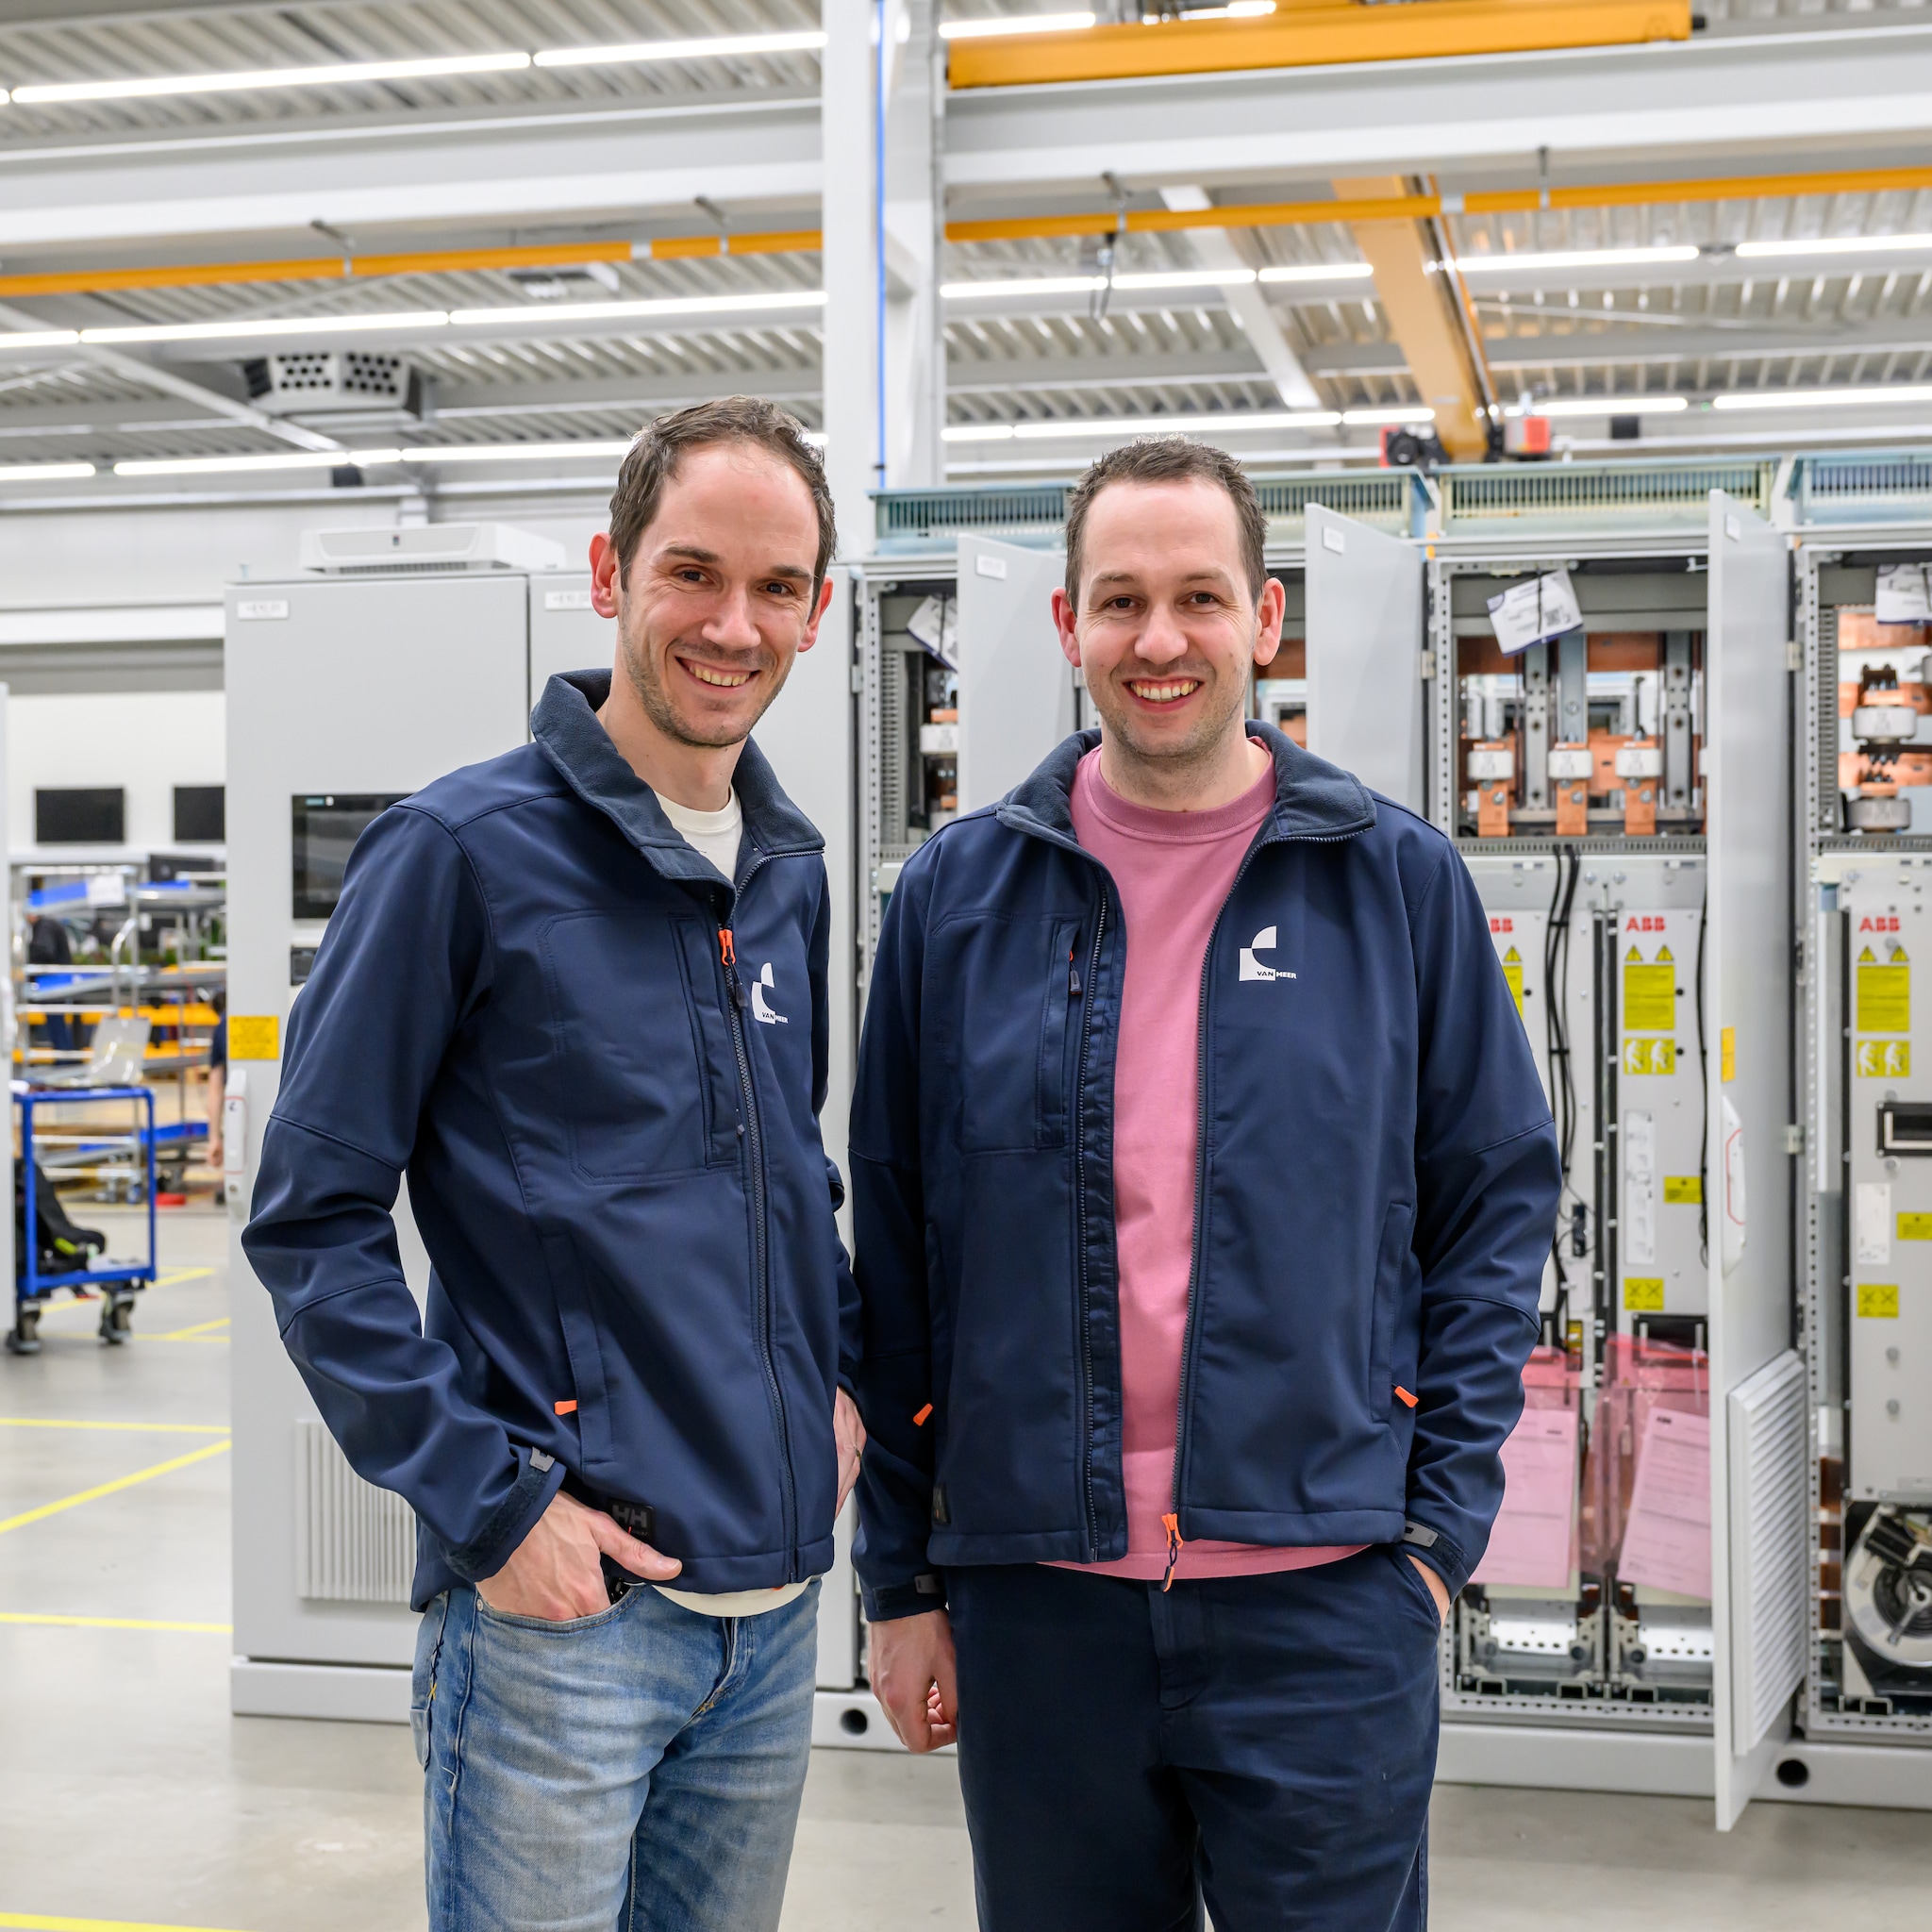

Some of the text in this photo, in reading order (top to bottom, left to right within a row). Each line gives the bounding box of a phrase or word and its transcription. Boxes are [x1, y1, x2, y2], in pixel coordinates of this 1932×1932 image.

[1489, 918, 1513, 933] BB
[1625, 916, 1666, 932] ABB
[1858, 916, 1901, 933] ABB
[1275, 971, 1297, 979] MEER
[761, 1011, 774, 1020] VAN
[612, 1505, 647, 1528] HH
